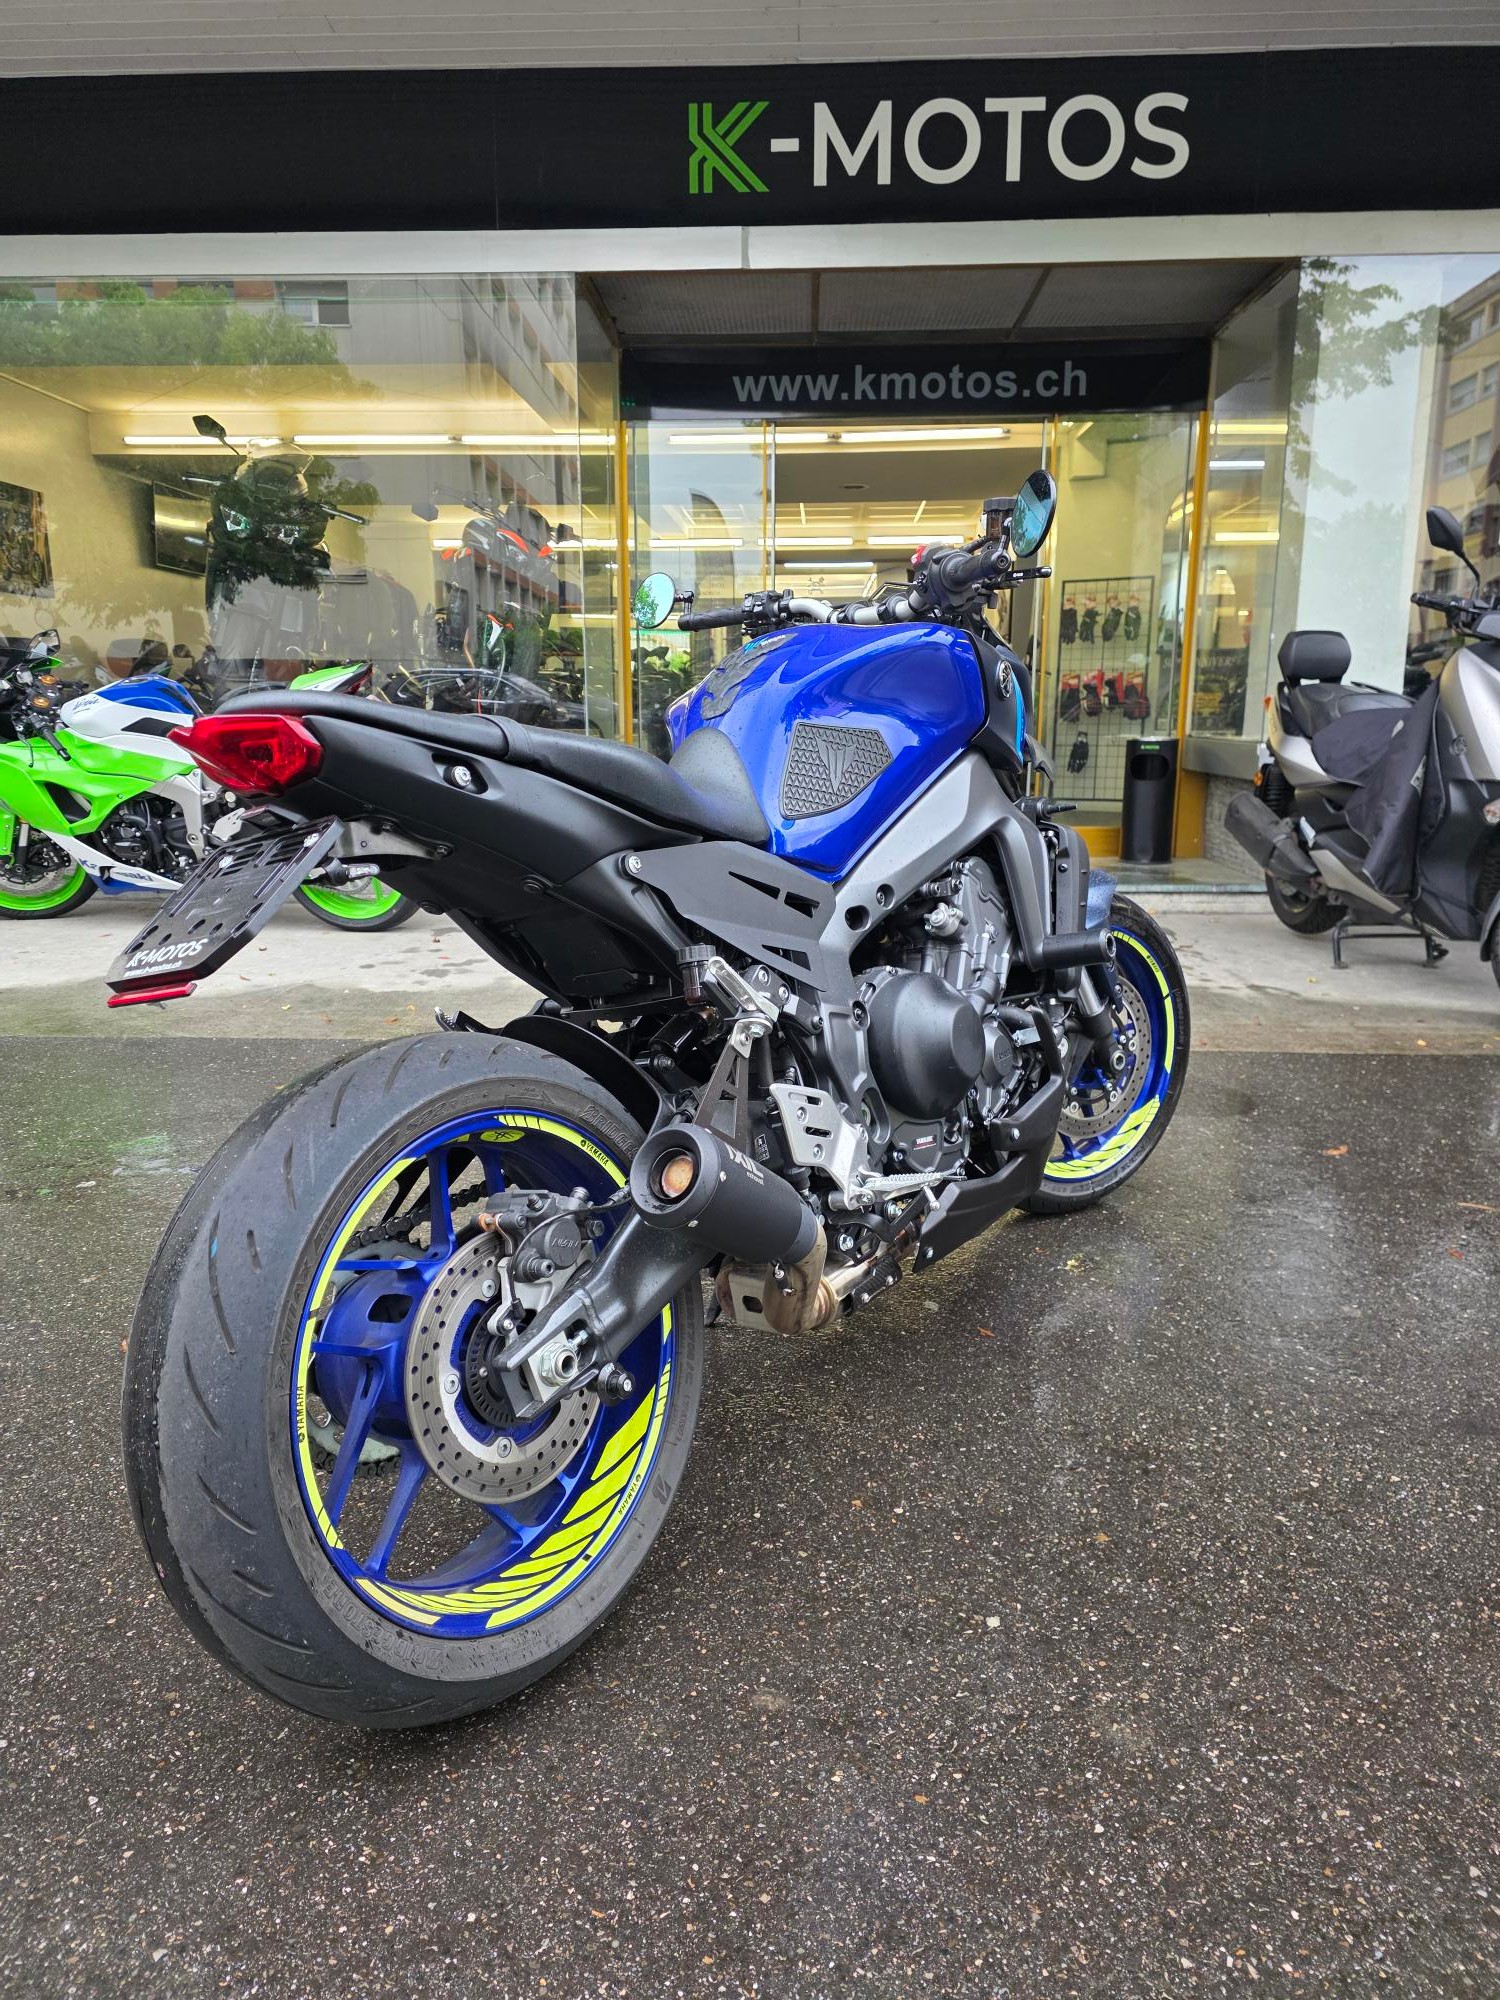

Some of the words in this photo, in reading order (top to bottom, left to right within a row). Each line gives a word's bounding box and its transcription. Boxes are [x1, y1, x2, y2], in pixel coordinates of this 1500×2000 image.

[688, 91, 1190, 194] K-MOTOS
[732, 360, 1088, 402] www.kmotos.ch
[125, 938, 208, 968] K-MOTOS
[586, 1142, 609, 1167] YAMAHA
[296, 1385, 305, 1430] YAMAHA
[617, 1482, 638, 1515] YAMAHA
